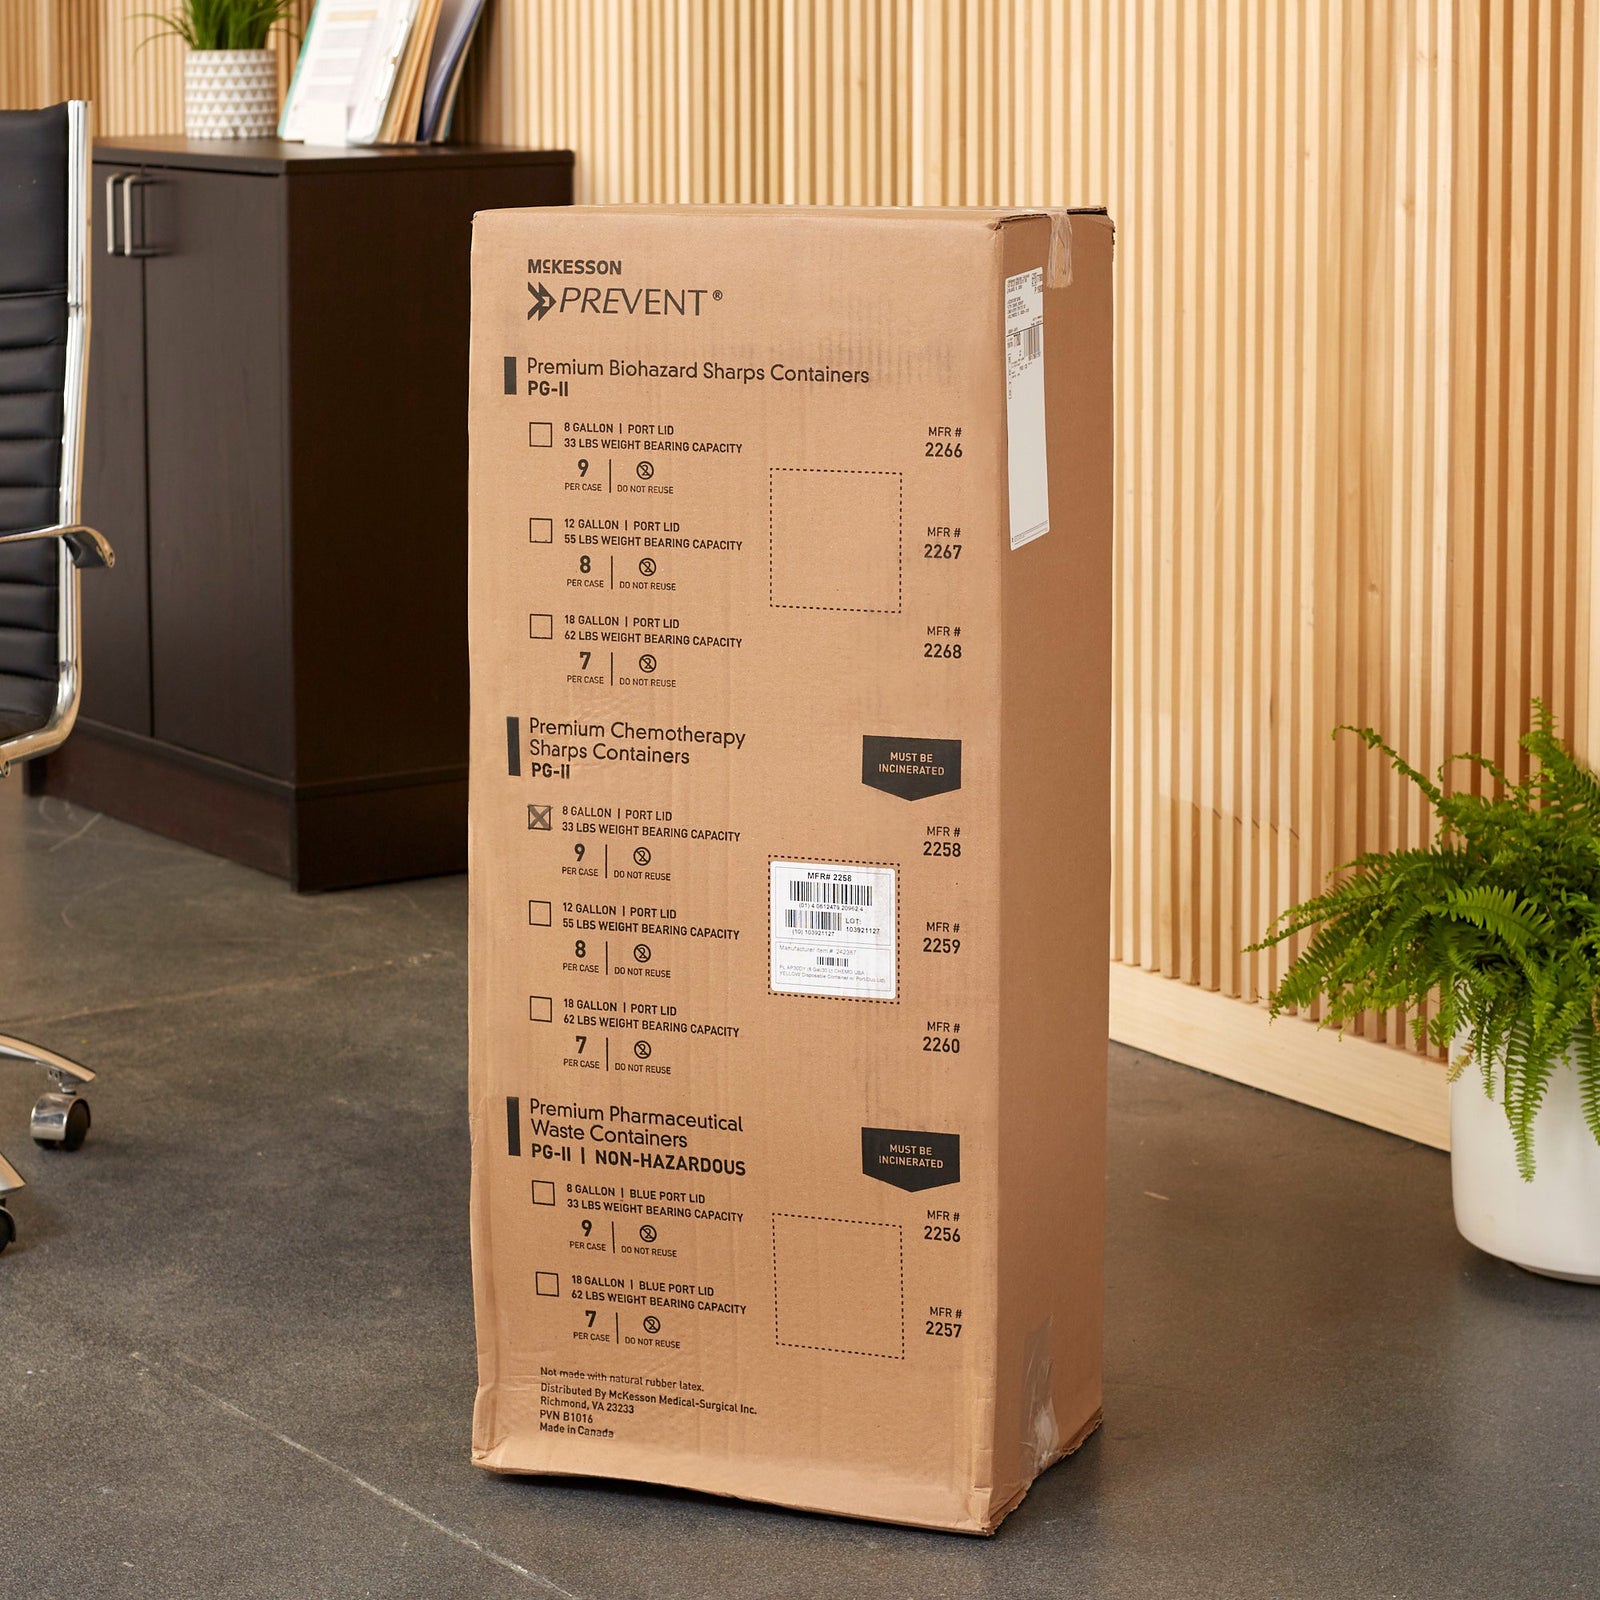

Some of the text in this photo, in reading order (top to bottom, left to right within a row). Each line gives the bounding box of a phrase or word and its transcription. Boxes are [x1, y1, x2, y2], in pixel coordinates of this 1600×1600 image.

[527, 357, 870, 385] Premium Biohazard Sharps Containers
[528, 380, 568, 397] PG-II
[564, 422, 674, 436] 8 GALLON PORT LID
[928, 426, 962, 438] MFR #
[564, 437, 743, 454] 33 LBS WEIGHT BEARING CAPACITY
[925, 441, 963, 458] 2266
[577, 459, 589, 477] 9
[564, 482, 602, 492] PER CASE
[564, 518, 680, 532] 12 GALLON PORT LID
[927, 526, 961, 538] MFR #
[924, 543, 962, 560] 2267
[579, 555, 591, 574] 8
[566, 578, 604, 588] PER CASE
[564, 614, 680, 629] 18 GALLON PORT LID
[564, 630, 743, 648] 62 LBS WEIGHT BEARING CAPACITY
[923, 642, 962, 659] 2268
[579, 651, 591, 670] 7
[530, 717, 746, 750] Premium Chemotherapy
[530, 738, 690, 765] Sharps Containers
[890, 752, 933, 763] MUST BE
[531, 762, 570, 780] PG-II
[879, 763, 944, 776] INCINERATED
[562, 805, 672, 822] 8 GALLON PORT LID
[562, 821, 741, 842] 33 LBS WEIGHT BEARING CAPACITY
[927, 826, 961, 838] MFR #
[574, 843, 585, 862] 9
[923, 841, 961, 858] 2258
[561, 866, 599, 877] PER CASE
[613, 870, 671, 881] DO NOT REUSE
[807, 872, 852, 882] MFR# 2258
[562, 902, 677, 919] 12 GALLON PORT LID
[575, 939, 586, 959] 8
[923, 937, 961, 954] 2259
[563, 998, 677, 1016] 18 GALLON PORT LID
[927, 1021, 960, 1034] MFR #
[575, 1035, 587, 1054] 7
[922, 1036, 960, 1054] 2260
[530, 1098, 744, 1132] Premium Pharmaceutical
[530, 1118, 688, 1148] Waste Containers
[890, 1144, 932, 1155] MUST BE
[531, 1143, 746, 1176] PG-II NON-HAZARDOUS
[879, 1156, 943, 1168] INCINERATED
[566, 1183, 705, 1204] 8 GALLON BLUE PORT LID
[567, 1198, 744, 1223] 33 LBS WEIGHT BEARING CAPACITY
[581, 1219, 592, 1237] 9
[924, 1225, 961, 1243] 2256
[571, 1274, 714, 1297] 18 GALLON BLUE PORT LID
[585, 1309, 597, 1328] 7
[929, 1306, 963, 1319] MFR #
[573, 1331, 610, 1342] PER CASE
[925, 1320, 962, 1338] 2257
[625, 1336, 681, 1349] DO NOT REUSE
[540, 1366, 704, 1392] Not made with natural rubber latex.
[540, 1382, 757, 1415] Distributed By McKesson Medical-Surgical Inc.
[540, 1395, 635, 1414] Richmond, VA 23233
[540, 1409, 593, 1424] PVN B1016
[540, 1422, 614, 1438] Made in Canada
